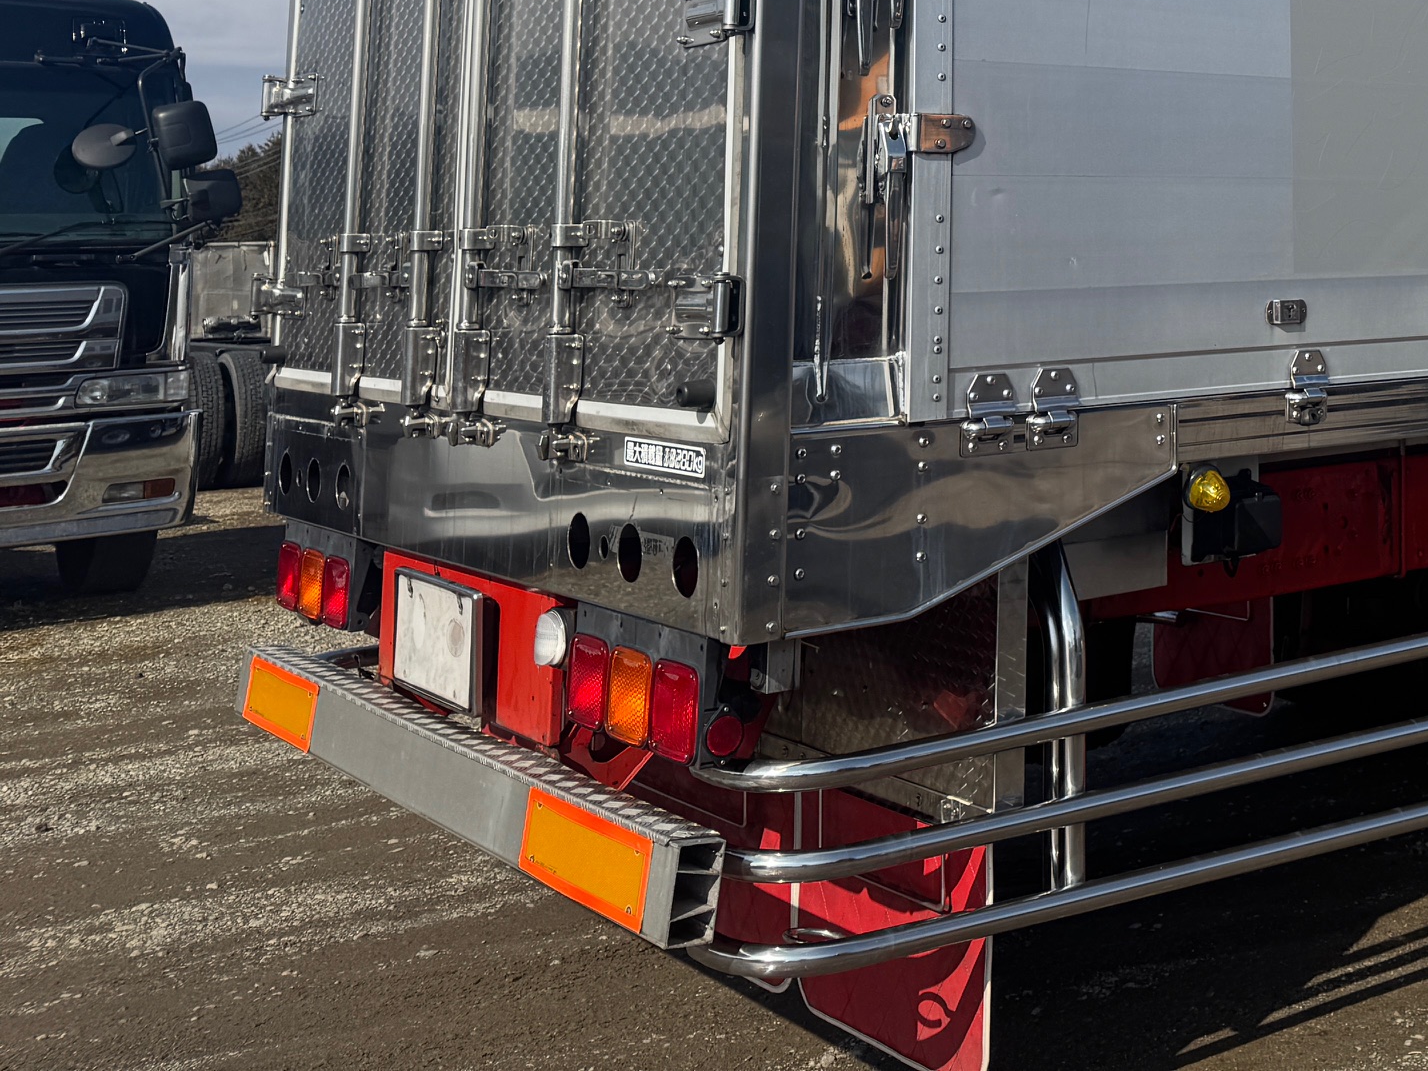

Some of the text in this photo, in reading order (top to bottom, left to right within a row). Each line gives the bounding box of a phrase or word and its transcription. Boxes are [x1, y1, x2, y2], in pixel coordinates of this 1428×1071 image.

[626, 441, 663, 466] 最大積載量
